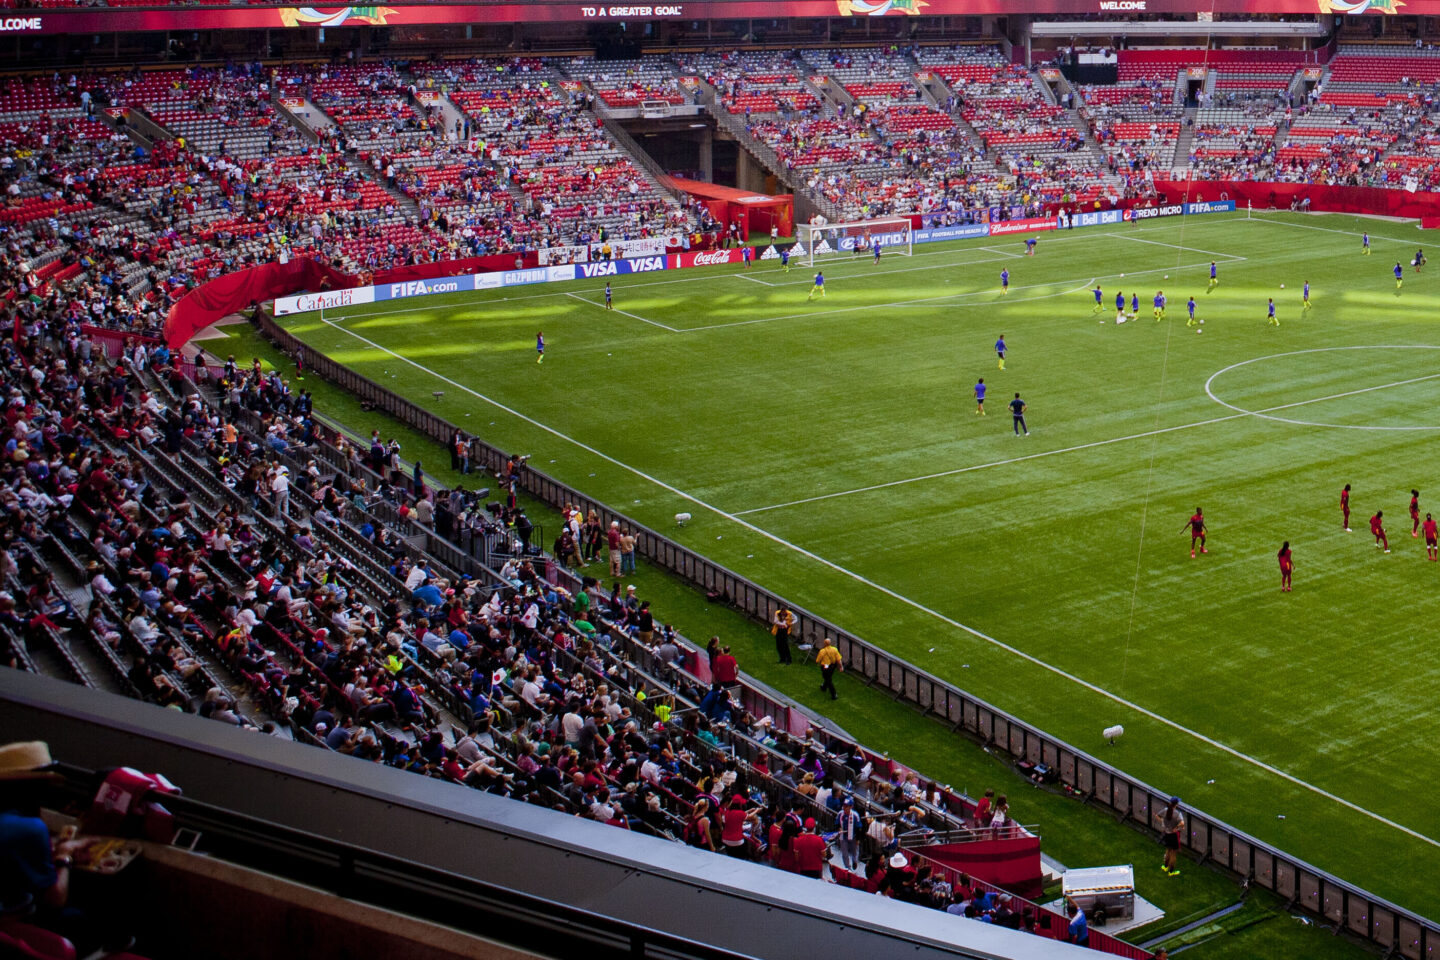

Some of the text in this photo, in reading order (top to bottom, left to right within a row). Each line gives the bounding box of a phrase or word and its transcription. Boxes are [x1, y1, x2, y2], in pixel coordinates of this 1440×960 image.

[582, 8, 596, 16] TO
[598, 8, 606, 16] A
[609, 6, 652, 16] GREATER
[1100, 1, 1146, 10] WELCOME
[0, 18, 42, 30] LCOME
[420, 92, 434, 100] 253
[284, 99, 298, 108] 252
[1160, 206, 1182, 216] MICRO
[1190, 203, 1228, 213] FIFA.com
[1063, 214, 1078, 227] Bll
[1083, 214, 1098, 225] Bell
[1102, 212, 1117, 223] Bell
[991, 223, 1028, 234] Budweiser
[628, 256, 664, 272] VISA
[694, 250, 732, 266] Coca-Cola
[580, 262, 618, 278] VISA
[505, 270, 546, 284] GAZPROM
[391, 280, 458, 298] FIFA.com
[297, 290, 352, 312] Canada
